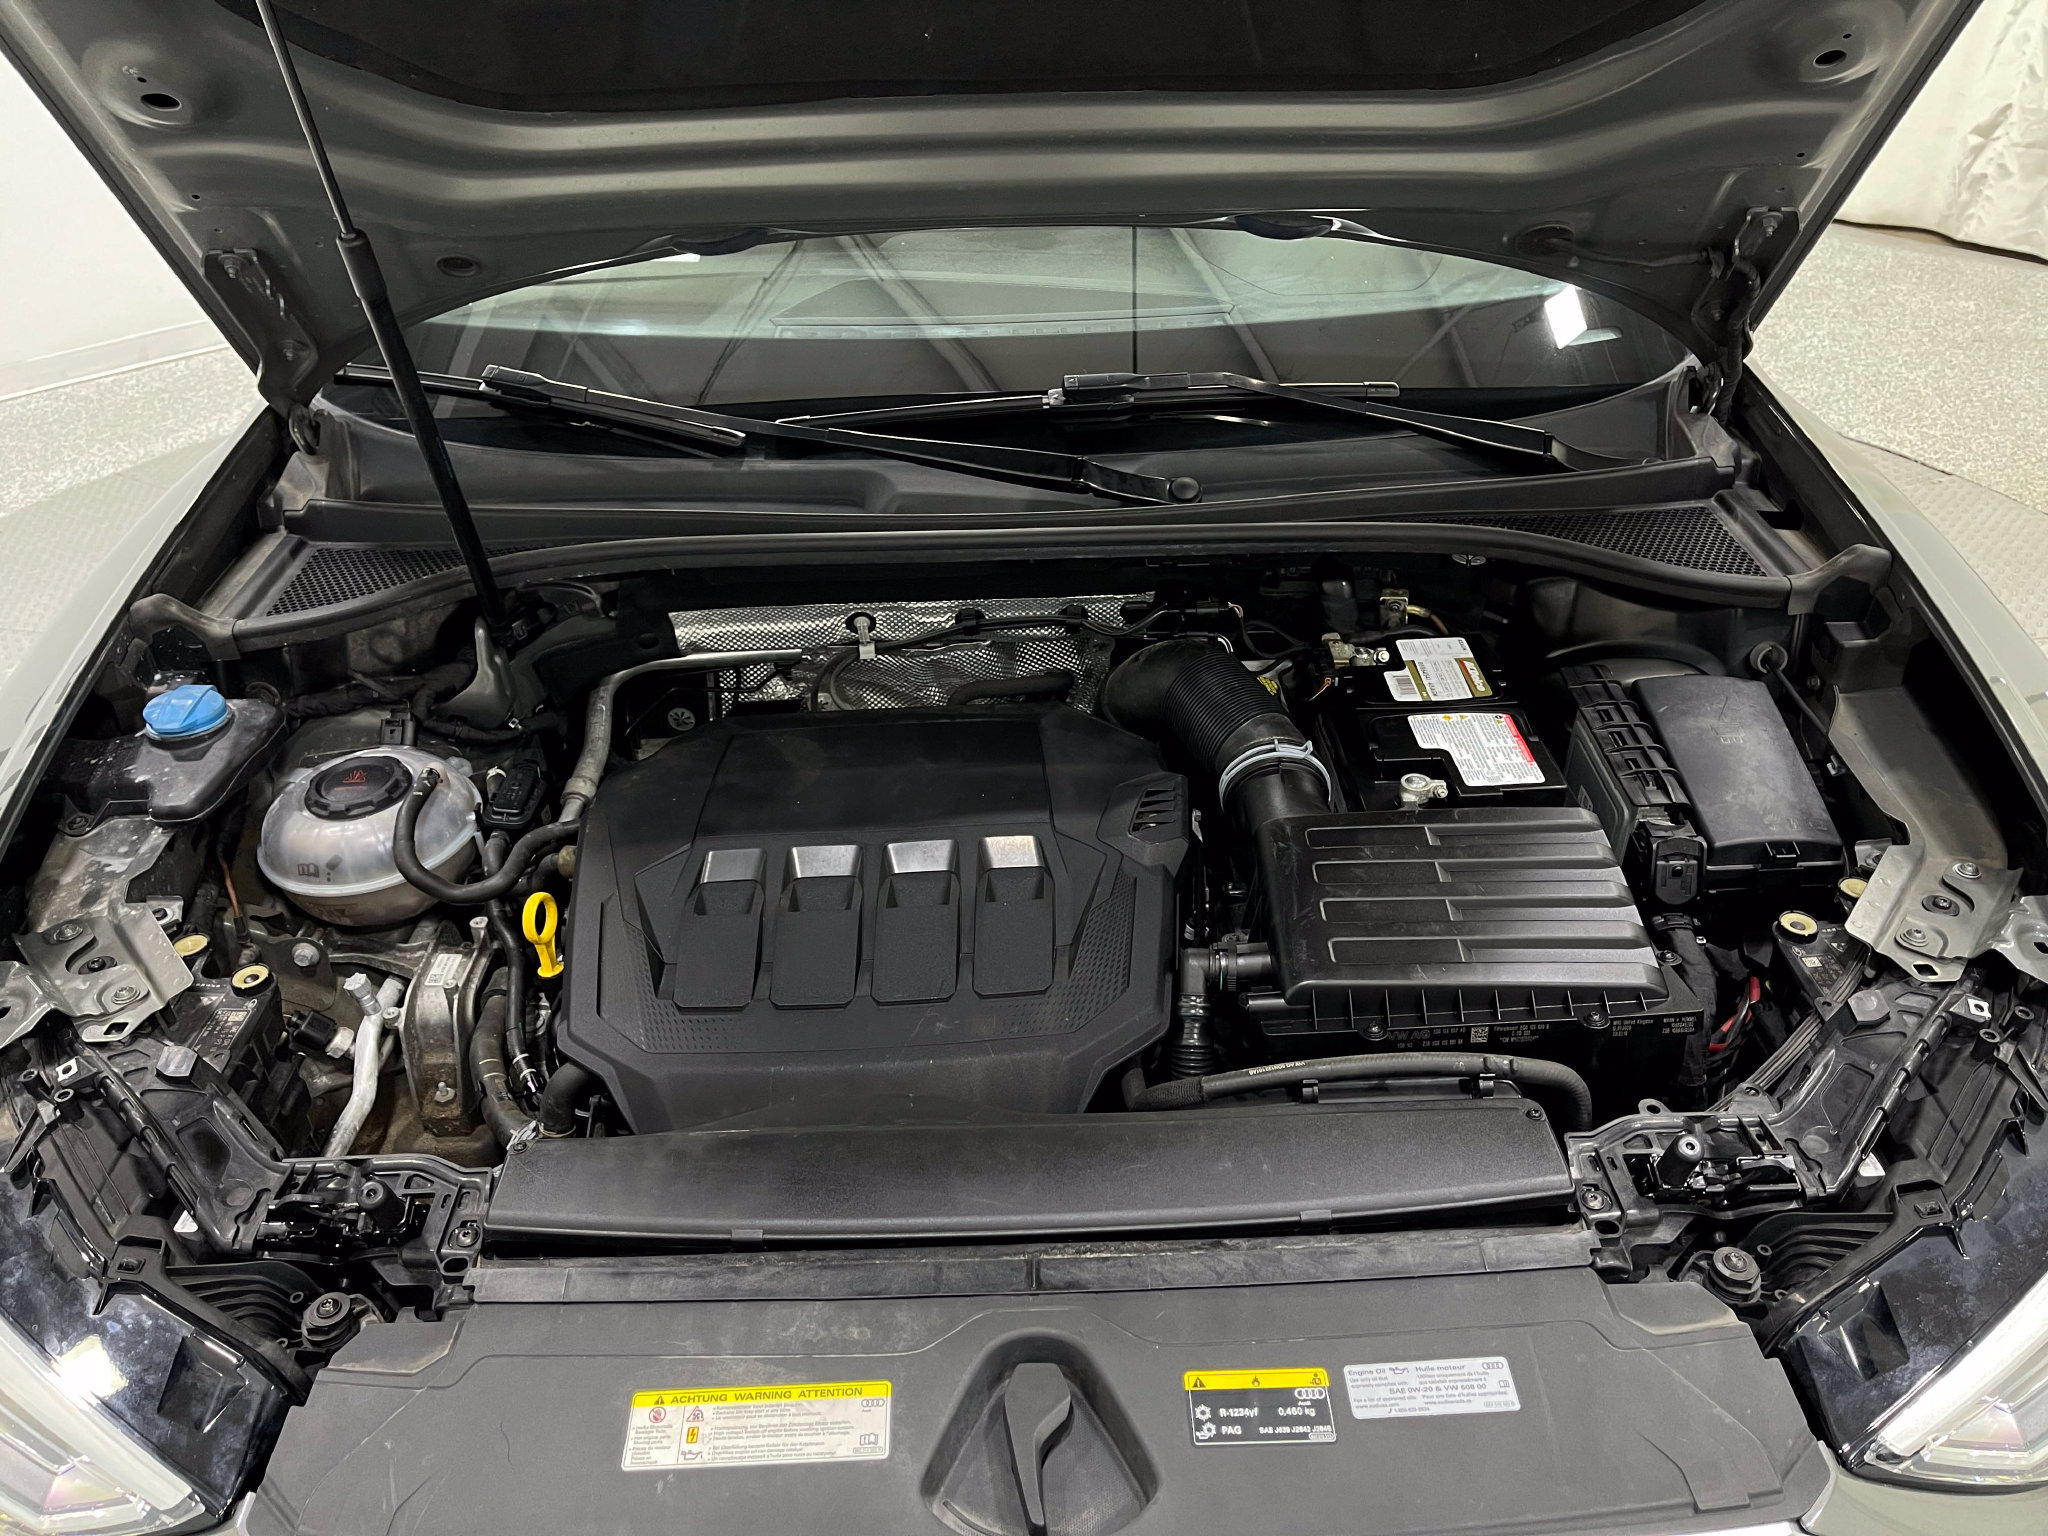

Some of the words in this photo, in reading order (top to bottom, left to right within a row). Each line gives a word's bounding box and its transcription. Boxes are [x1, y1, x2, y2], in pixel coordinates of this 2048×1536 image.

[1387, 1031, 1409, 1040] VW
[1411, 1029, 1431, 1040] AG
[671, 1393, 728, 1404] ACHTUNG
[734, 1390, 792, 1401] WARNING
[798, 1386, 863, 1398] ATTENTION
[1408, 1386, 1434, 1394] 0W-20
[1219, 1408, 1258, 1418] R-1234yf
[1278, 1407, 1303, 1417] 0,460
[1304, 1406, 1316, 1417] kg
[1222, 1426, 1242, 1435] PAG
[1259, 1426, 1273, 1434] SAE
